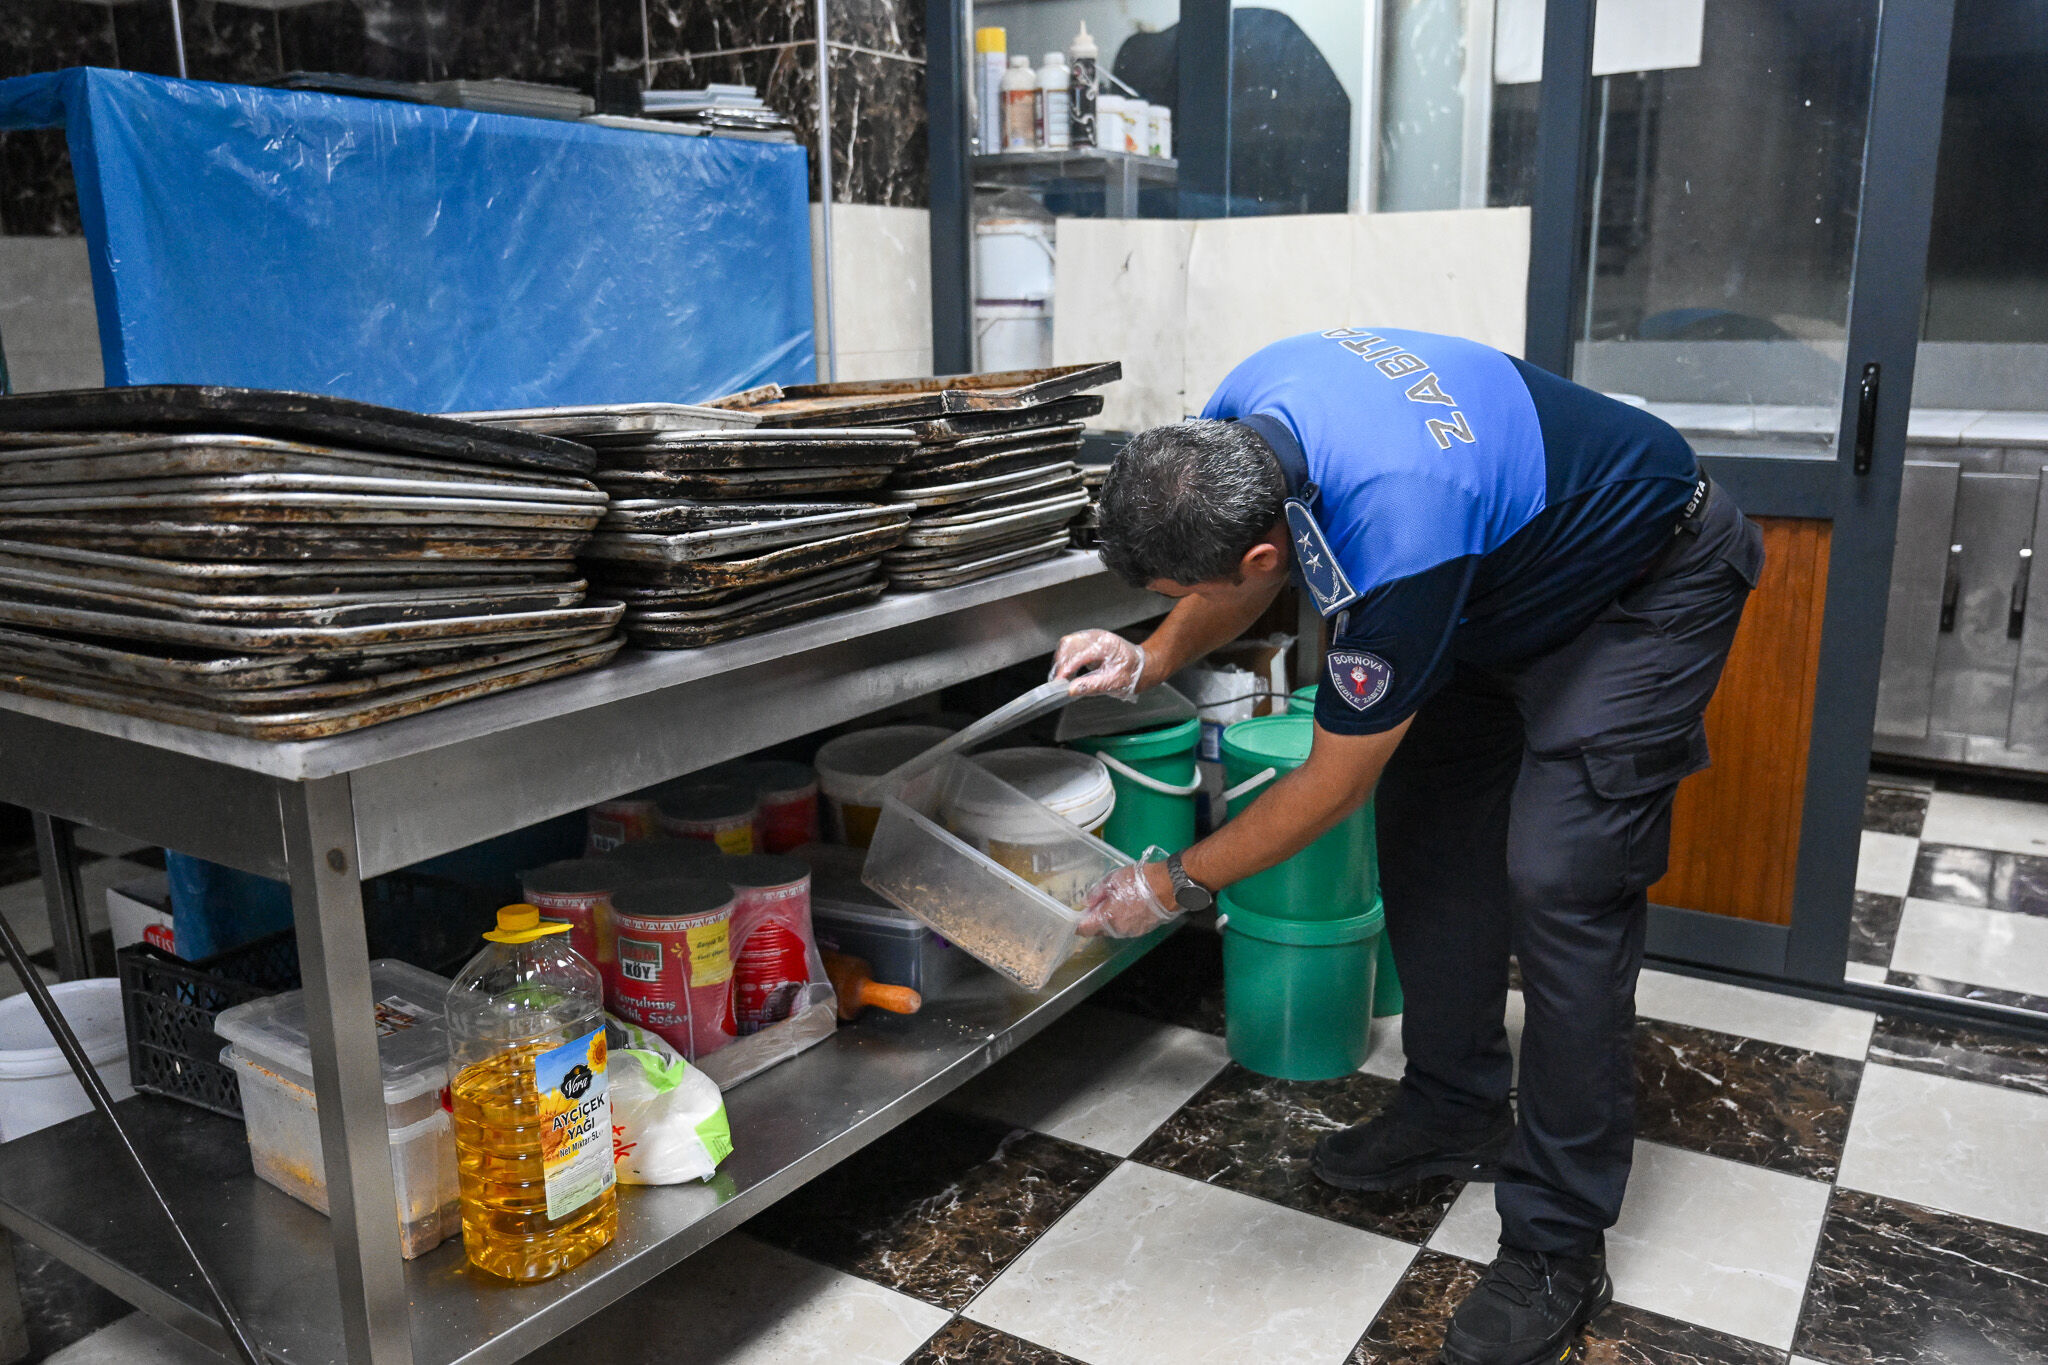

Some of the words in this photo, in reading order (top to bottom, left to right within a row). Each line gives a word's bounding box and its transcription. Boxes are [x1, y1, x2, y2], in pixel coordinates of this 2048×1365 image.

[1321, 327, 1476, 450] ZABITA
[1333, 655, 1383, 672] BORNOVA
[625, 960, 651, 979] KÖY
[564, 1073, 588, 1096] Vera
[552, 1093, 605, 1131] AYÇİÇEK
[567, 1117, 595, 1140] YAĞI
[559, 1147, 571, 1158] Net
